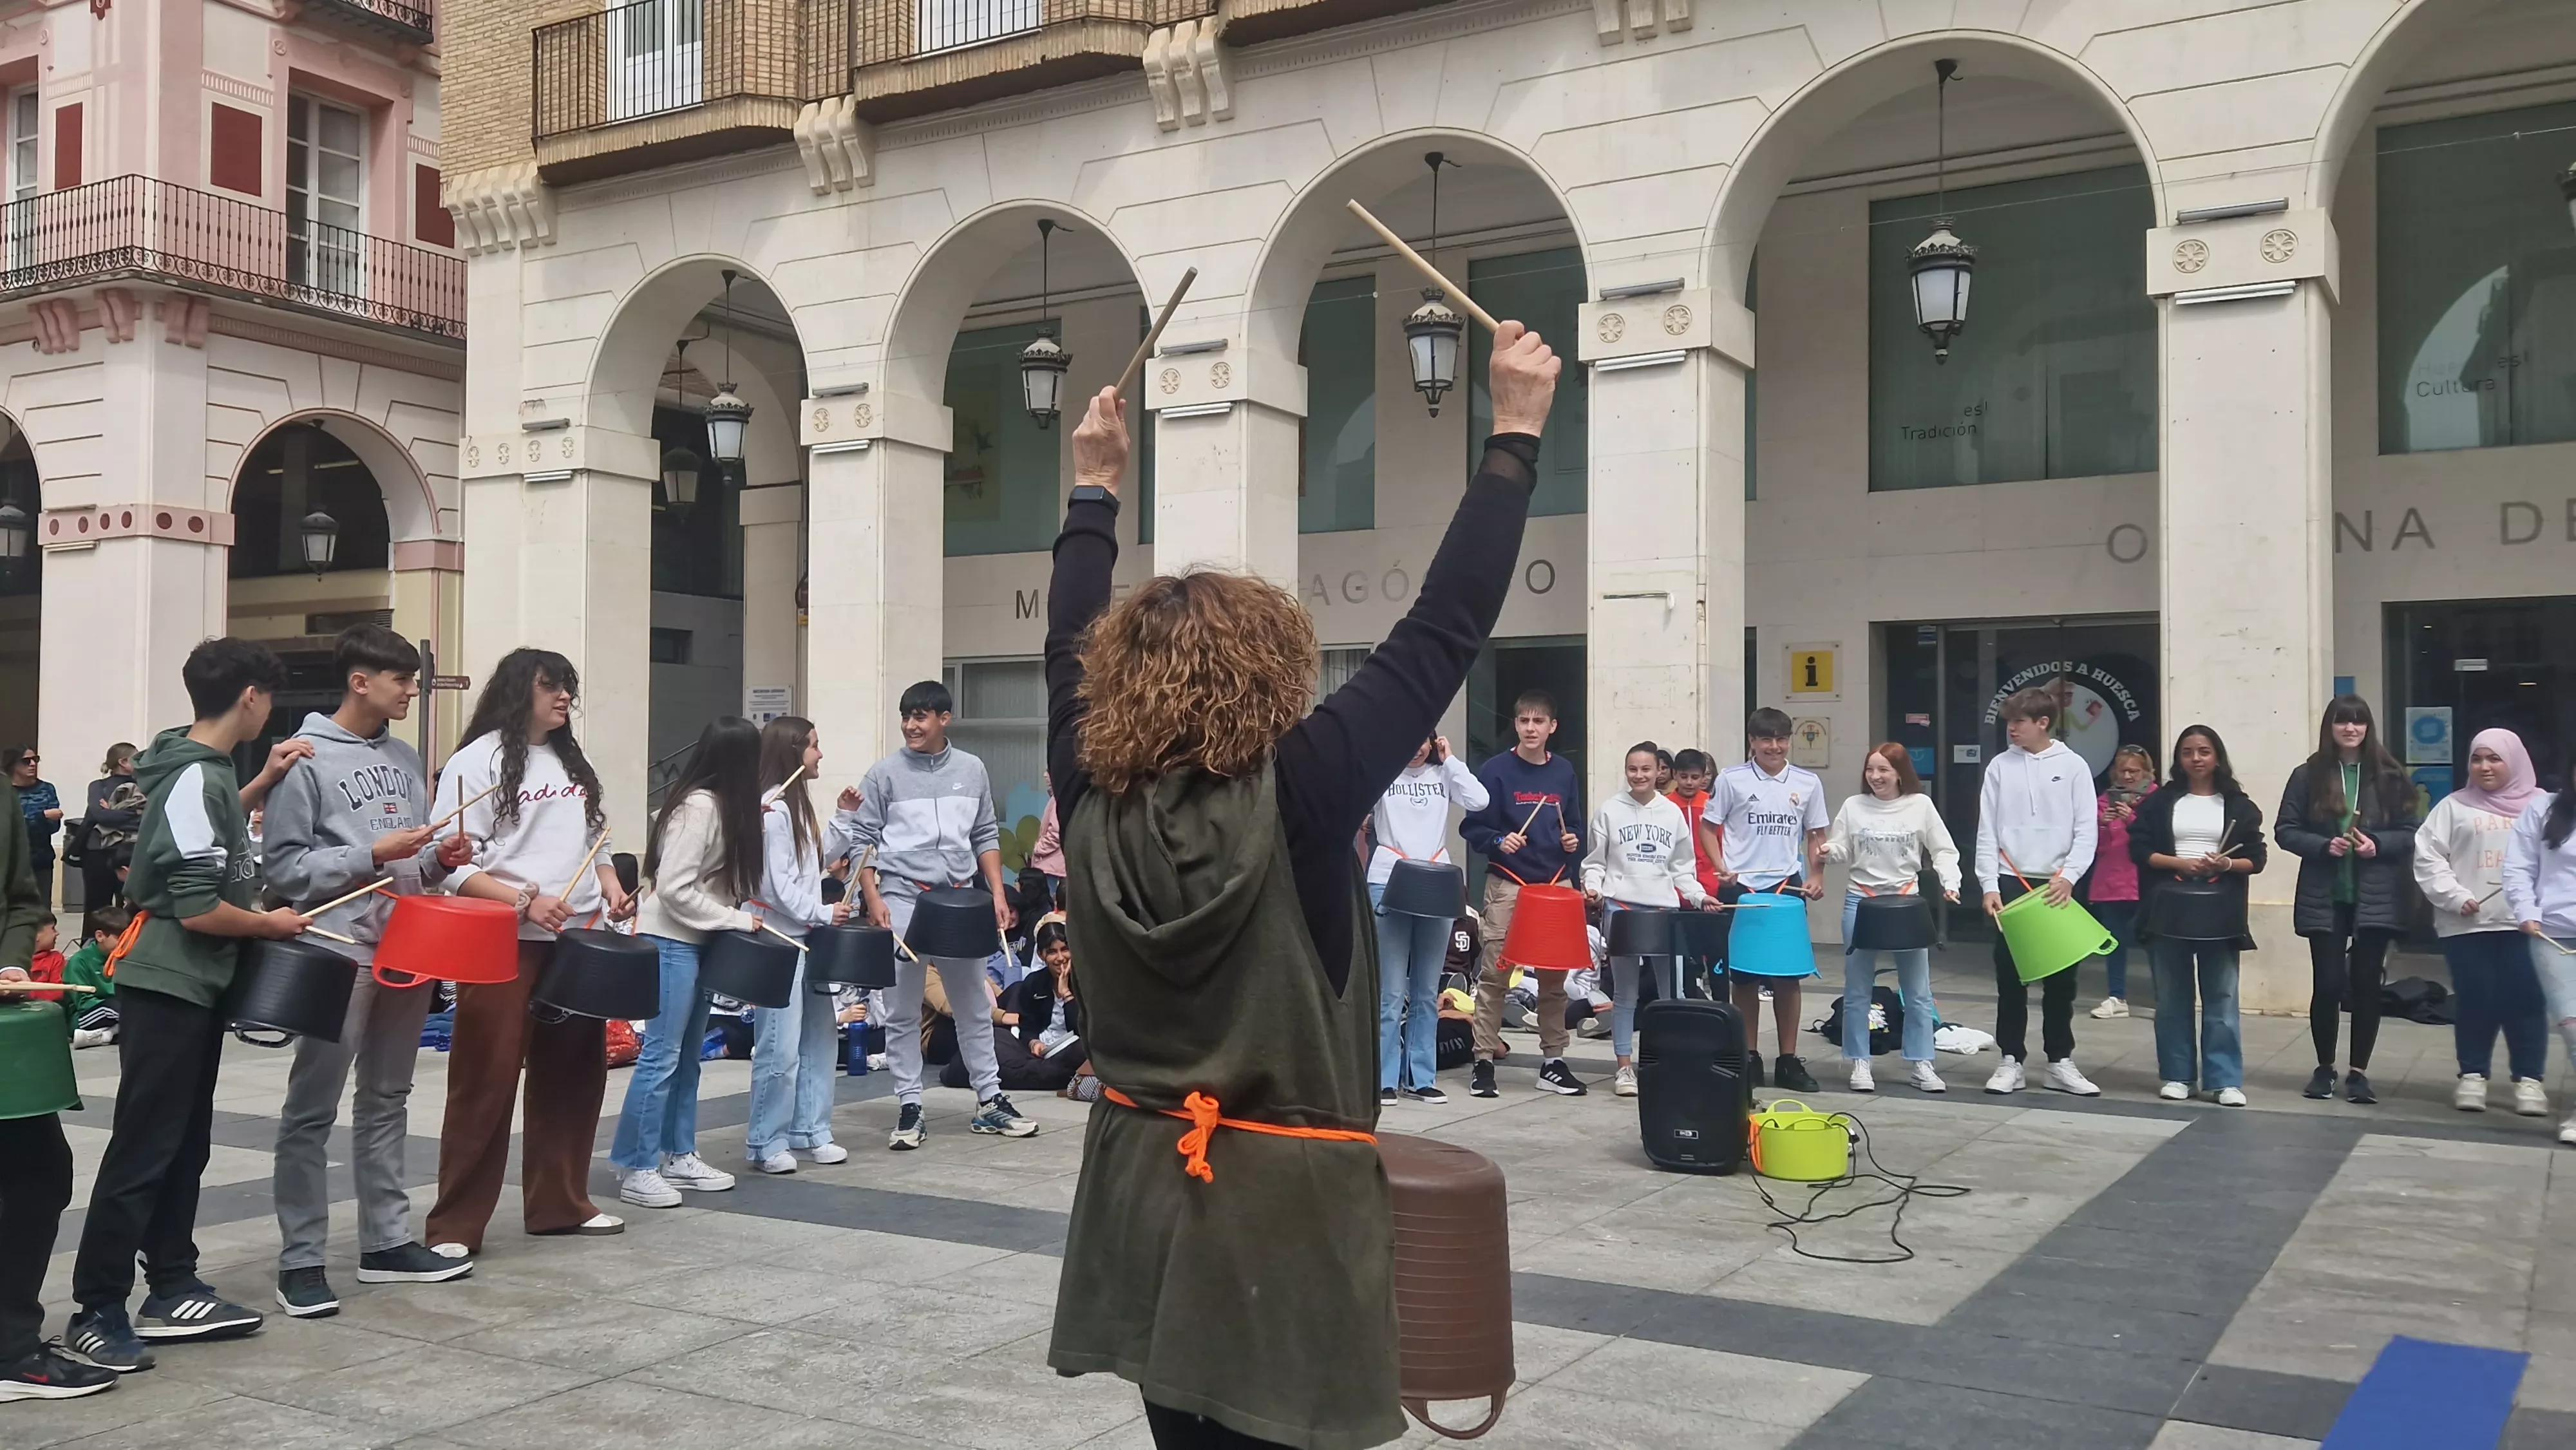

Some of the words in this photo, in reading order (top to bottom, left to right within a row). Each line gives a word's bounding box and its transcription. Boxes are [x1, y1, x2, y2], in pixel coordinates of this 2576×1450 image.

[2417, 379, 2496, 397] Cultura
[1901, 421, 1977, 440] Tradición
[1984, 661, 2073, 725] BIENVENIDOS
[2075, 663, 2088, 675] A
[2090, 668, 2141, 722] HUESCA
[1387, 782, 1446, 798] HOLLISTER
[1748, 811, 1797, 825] Emirates
[1618, 824, 1642, 845] NEW
[1645, 824, 1672, 849] YORK
[1757, 825, 1768, 836] FLY
[1768, 825, 1791, 836] BETTER
